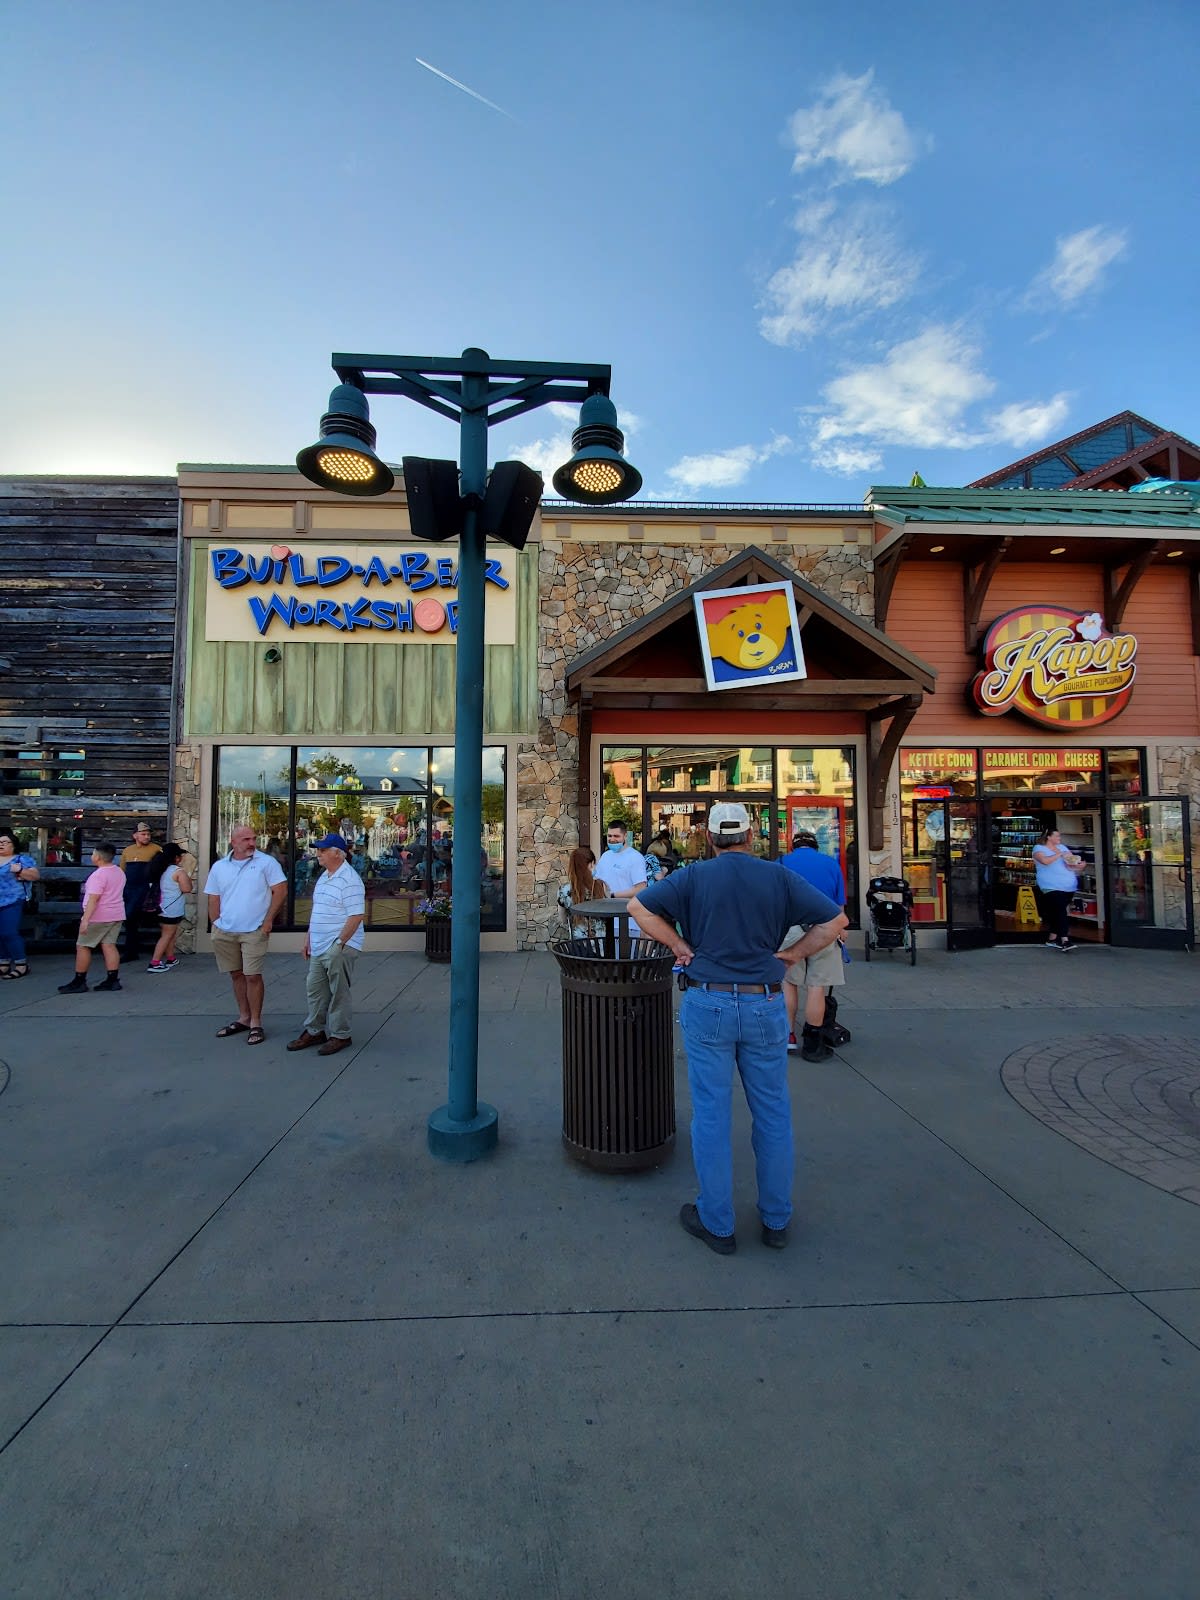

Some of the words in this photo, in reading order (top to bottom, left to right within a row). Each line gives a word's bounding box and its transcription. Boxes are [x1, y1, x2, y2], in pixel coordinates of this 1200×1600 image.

[981, 627, 1137, 706] Kapop
[1063, 680, 1093, 691] GOURMET
[1094, 675, 1123, 687] POPCORN
[908, 753, 945, 767] KETTLE
[947, 753, 973, 767] CORN
[986, 753, 1030, 767] CARAMEL
[1032, 753, 1058, 767] CORN
[1064, 753, 1099, 767] CHEESE
